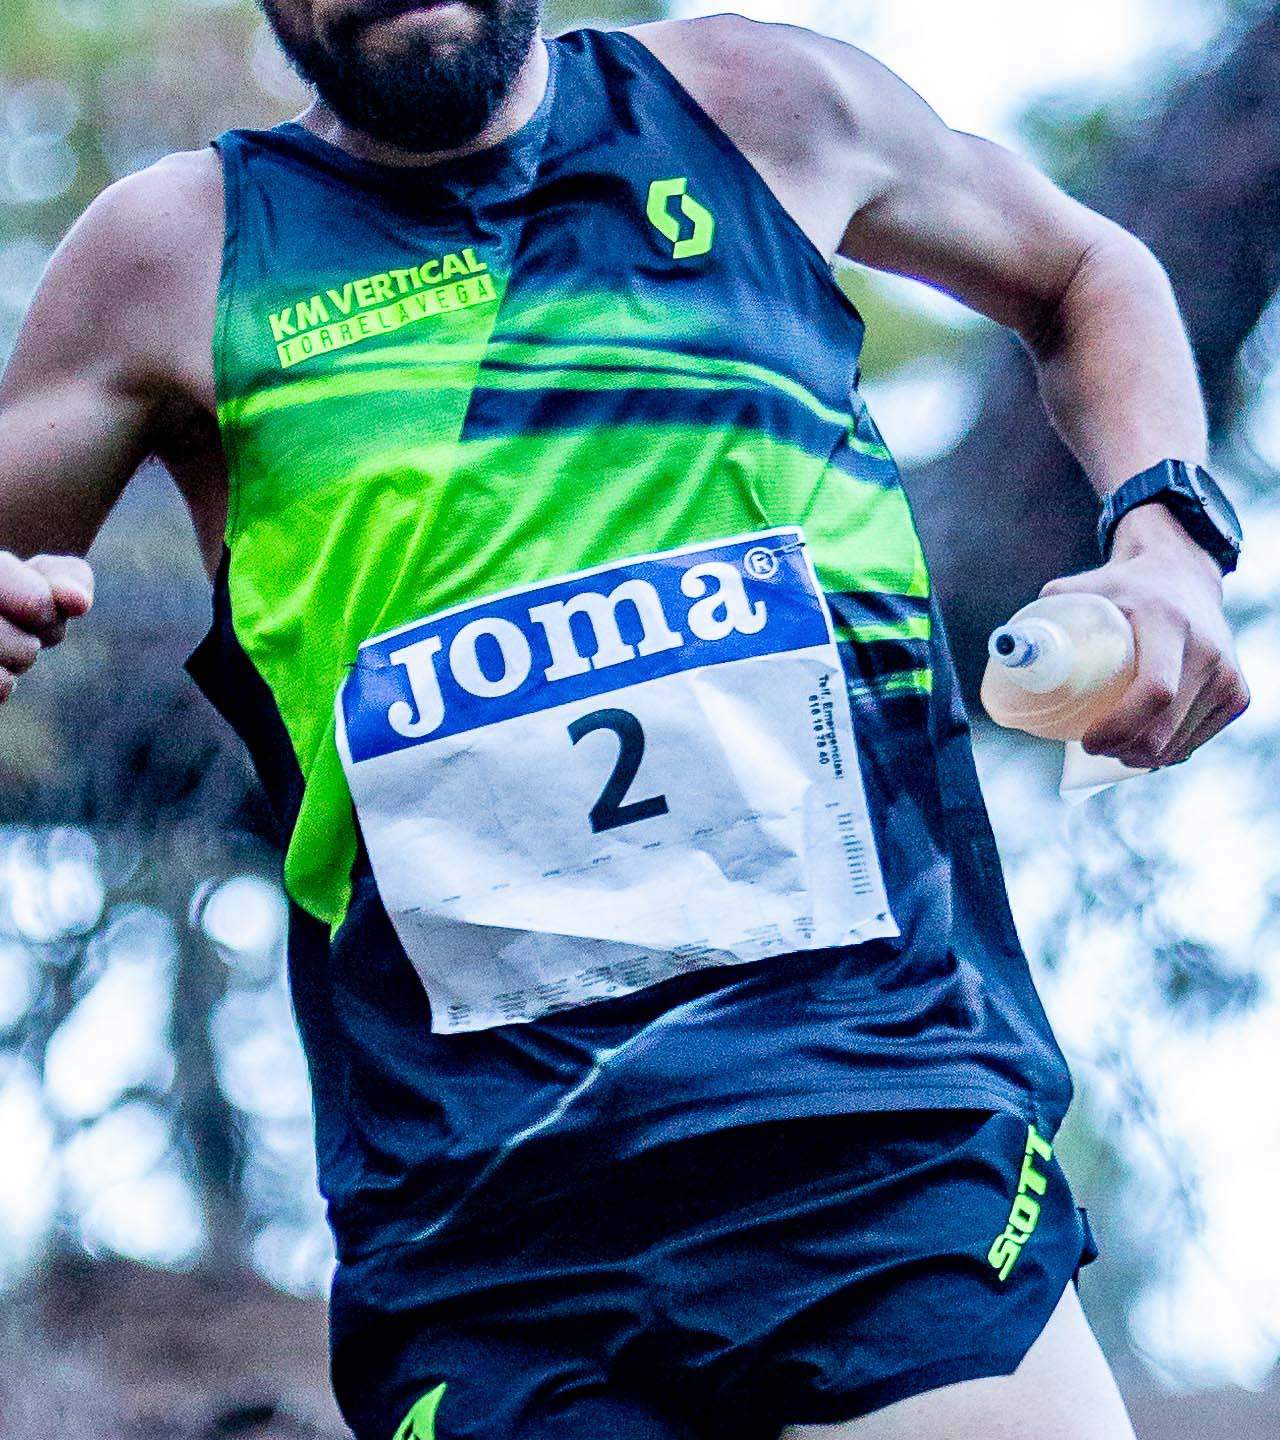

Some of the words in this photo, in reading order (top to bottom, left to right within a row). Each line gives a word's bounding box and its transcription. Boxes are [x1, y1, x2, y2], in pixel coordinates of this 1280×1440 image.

[269, 295, 329, 341] KM
[326, 248, 488, 315] VERTICAL
[281, 278, 491, 363] TORRELAVEGA
[567, 708, 670, 834] 2
[987, 1124, 1053, 1281] SCOTT
